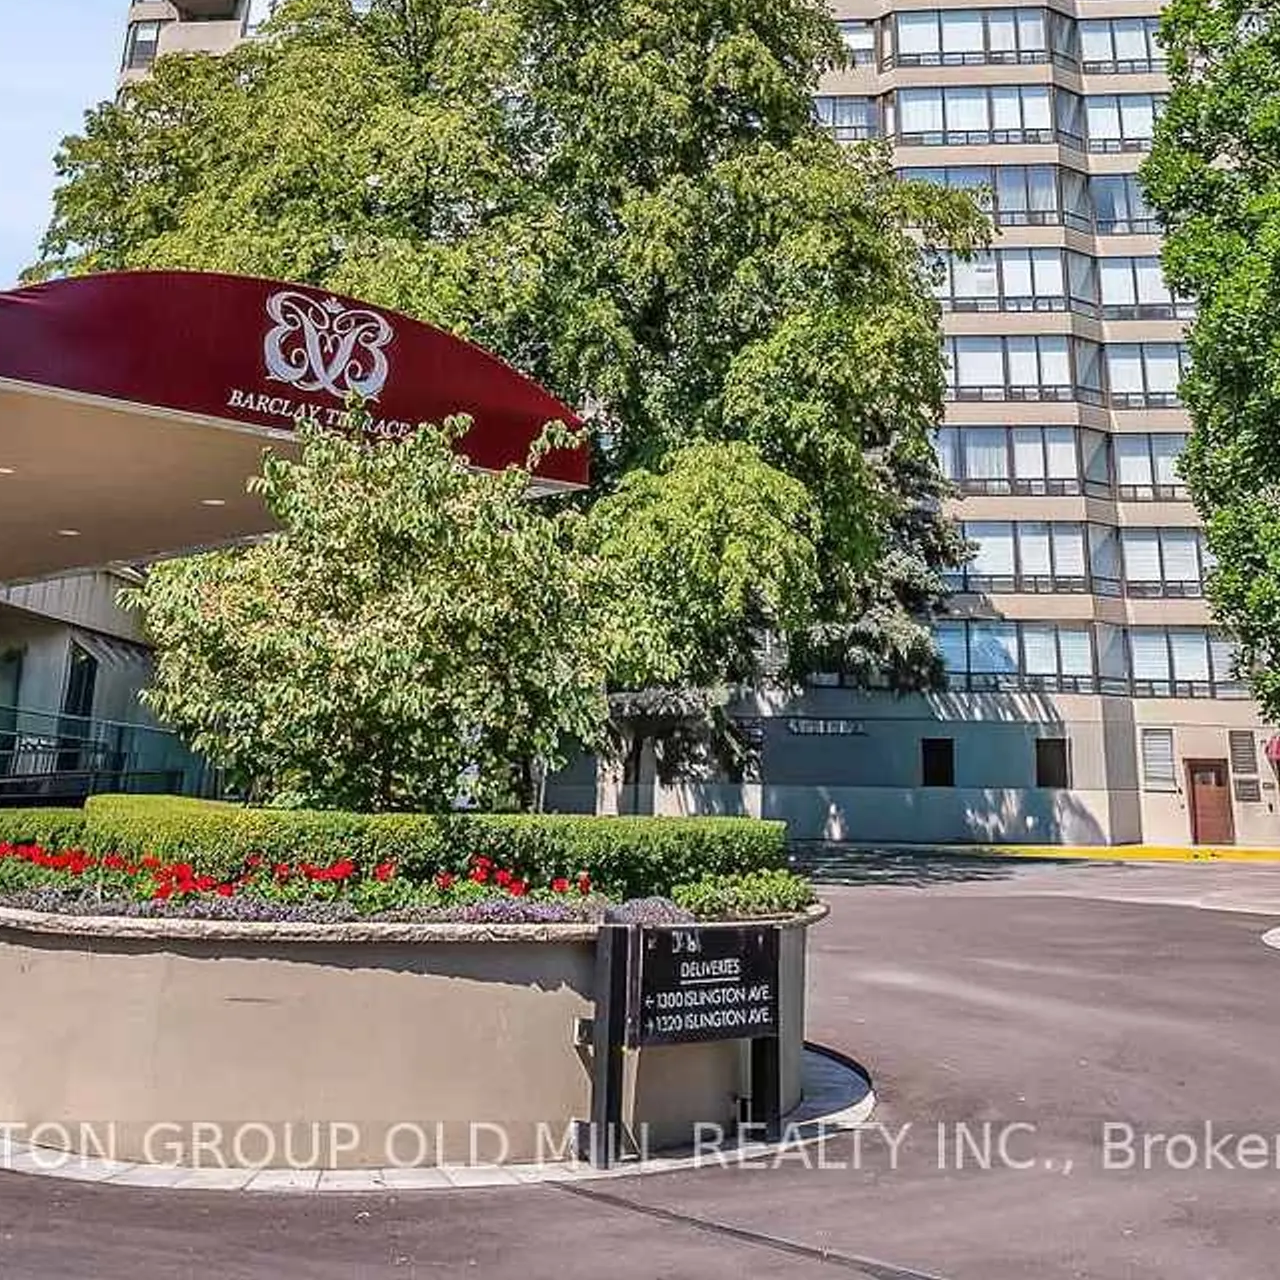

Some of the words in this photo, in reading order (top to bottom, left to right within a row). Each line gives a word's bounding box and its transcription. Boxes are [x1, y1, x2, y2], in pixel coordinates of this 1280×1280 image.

[227, 389, 321, 421] BARCLAY
[679, 957, 740, 978] DELIVERIES
[656, 991, 683, 1009] 1300
[684, 987, 746, 1007] ISLINGTON
[656, 1013, 683, 1032] 1320
[684, 1008, 746, 1030] ISLINGTON
